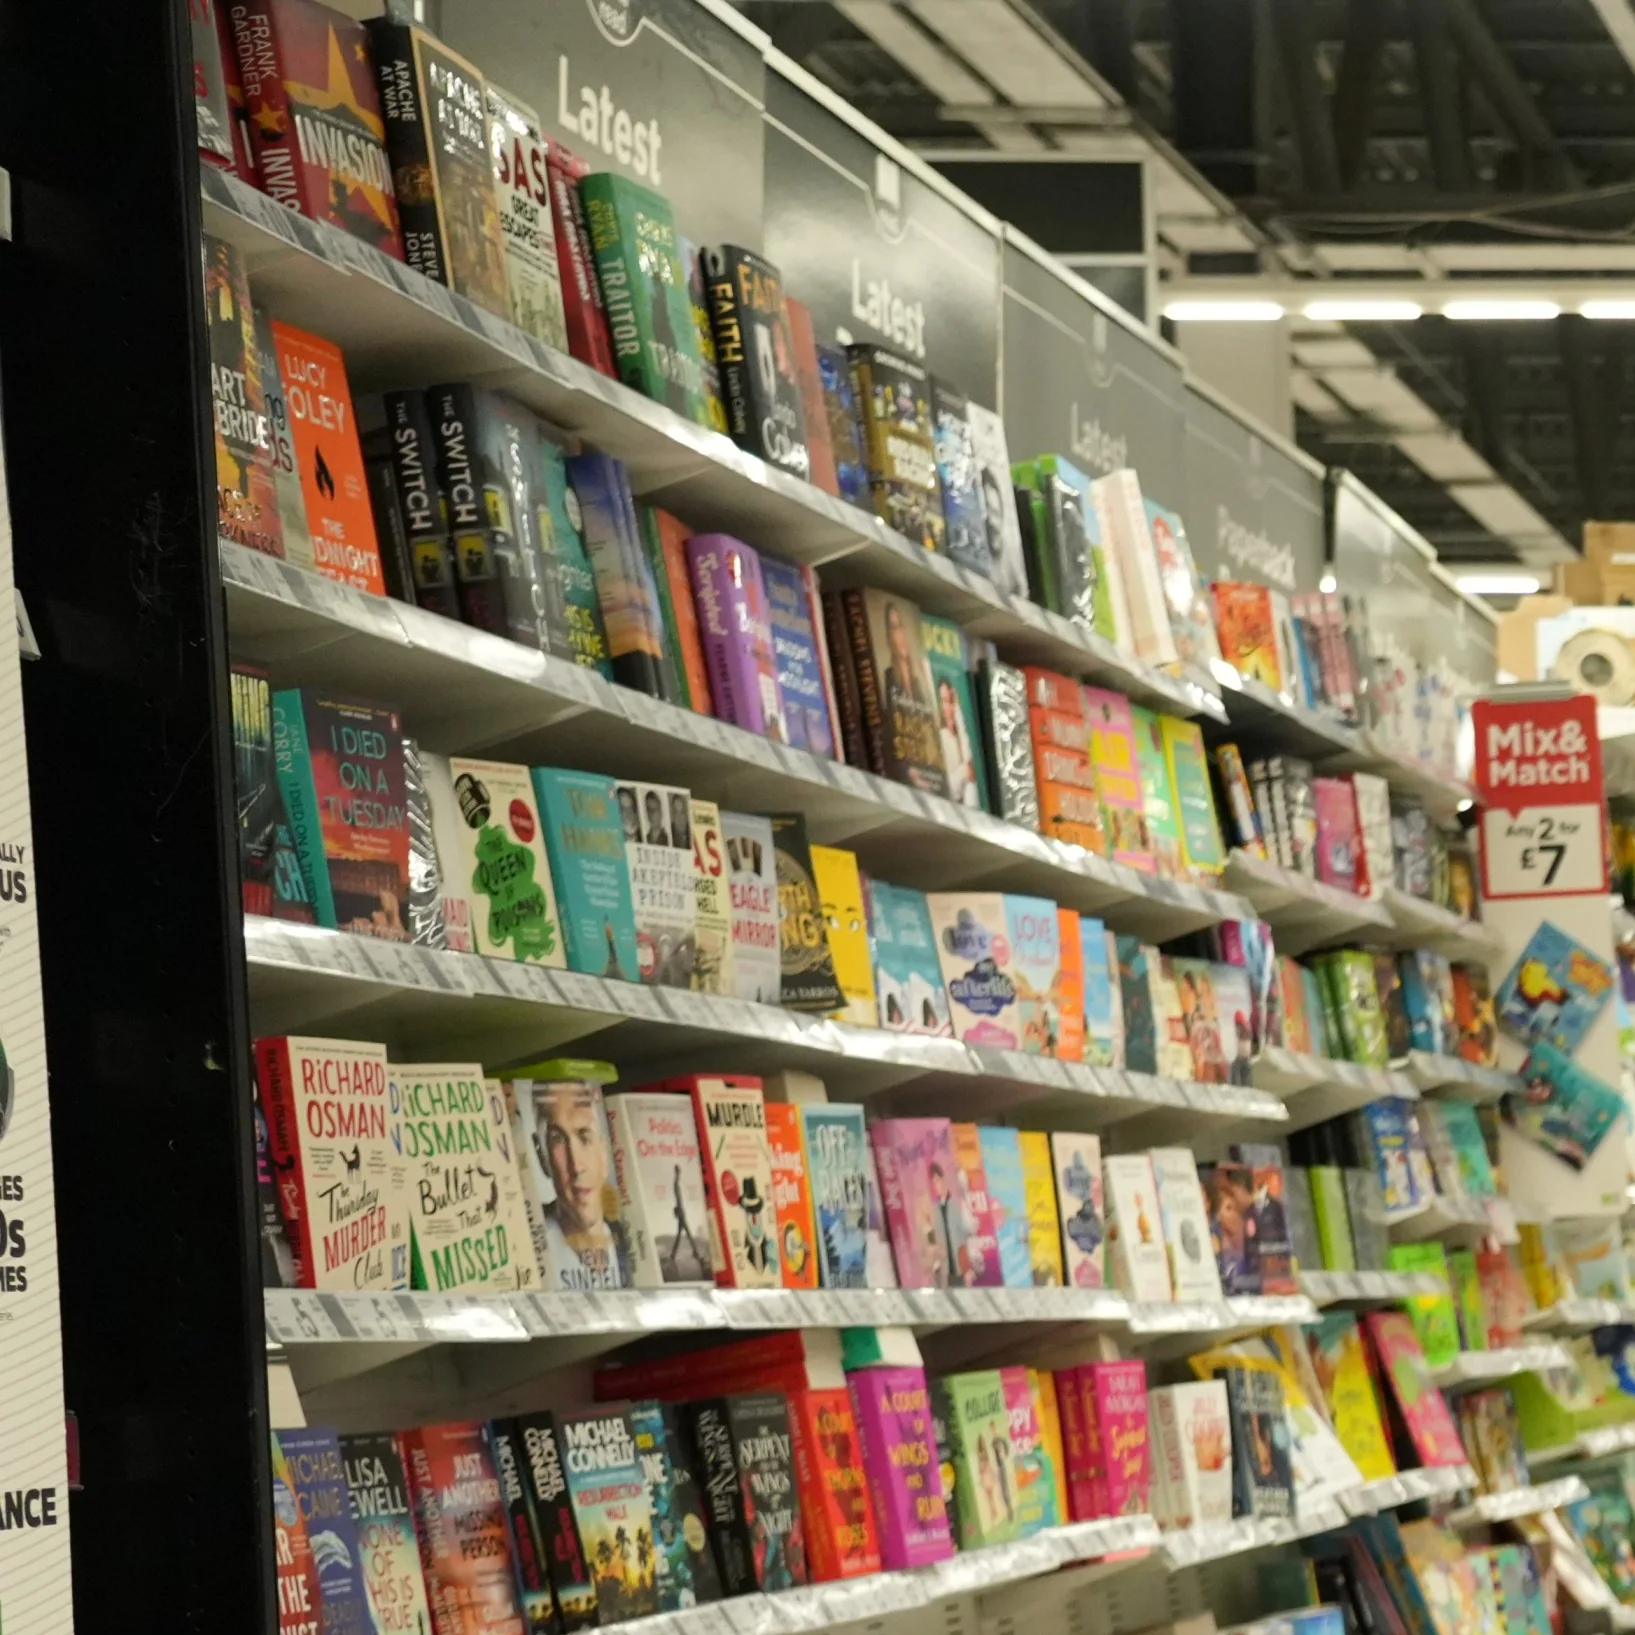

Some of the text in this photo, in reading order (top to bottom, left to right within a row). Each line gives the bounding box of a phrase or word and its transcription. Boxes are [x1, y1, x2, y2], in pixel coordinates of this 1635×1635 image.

[231, 6, 262, 97] GARDNER
[250, 14, 279, 79] FRANK
[384, 85, 399, 119] WAR
[394, 60, 417, 122] APACHE
[558, 54, 662, 187] Latest
[295, 114, 396, 197] INVASION
[599, 257, 641, 358] TRAITOR
[710, 283, 742, 364] FAITH
[851, 257, 926, 358] Latest
[285, 354, 327, 390] LUCY
[394, 428, 434, 531] SWITCH
[440, 421, 479, 524] SWITCH
[272, 707, 293, 774] CORRY
[341, 729, 387, 760] DIED
[339, 761, 391, 795] ON A
[1489, 755, 1590, 789] Match
[325, 797, 405, 832] TUESDAY
[1504, 816, 1581, 841] Any 2 for
[1519, 844, 1567, 887] £7
[730, 883, 772, 914] EAGLE
[731, 920, 778, 950] MIRROR
[306, 1100, 387, 1140] OSMAN
[705, 1100, 764, 1129] MURDLE
[418, 1166, 478, 1216] Bullet
[458, 1205, 483, 1230] That
[323, 1205, 387, 1273] MURDER
[430, 1224, 510, 1292] MISSED
[353, 1250, 384, 1290] Club
[563, 1417, 631, 1450] MICHAEL
[344, 1455, 389, 1490] LISA
[452, 1452, 483, 1480] JUST
[566, 1440, 636, 1474] CONNELLY
[349, 1486, 408, 1520] EWELL
[371, 1551, 396, 1578] OF
[278, 1574, 312, 1616] THE
